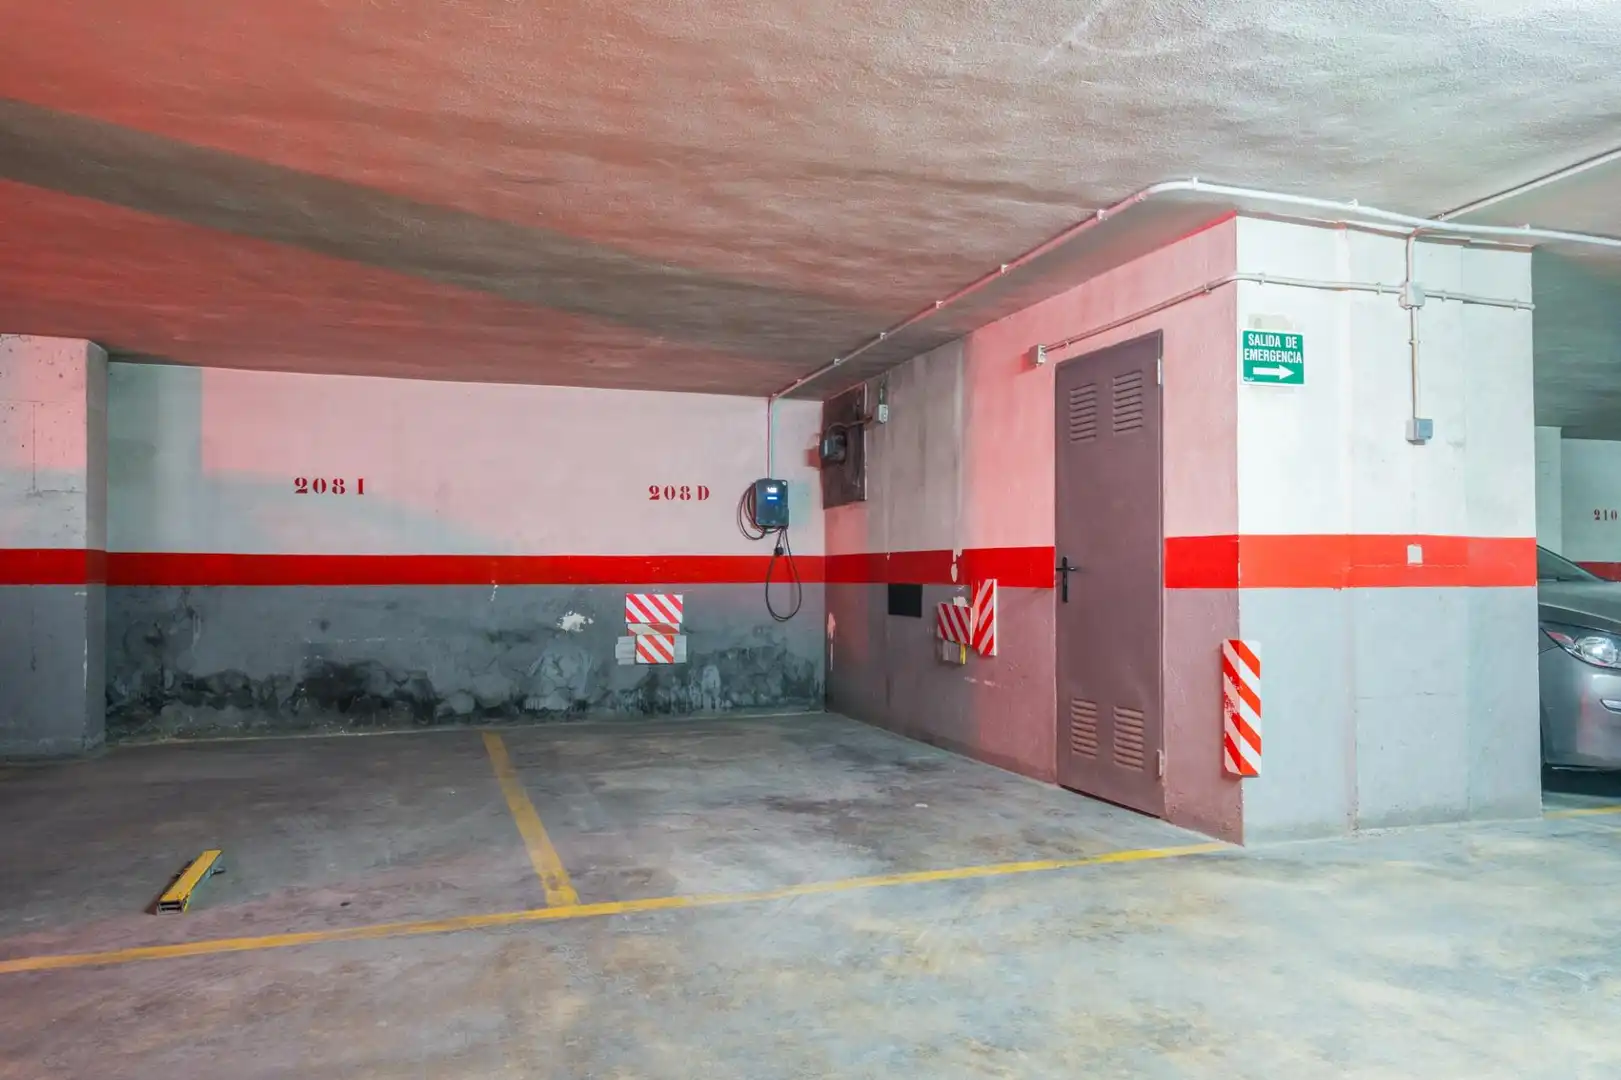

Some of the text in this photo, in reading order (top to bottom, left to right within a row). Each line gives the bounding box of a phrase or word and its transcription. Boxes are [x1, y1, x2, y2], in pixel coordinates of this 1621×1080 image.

[1248, 333, 1298, 349] SALIDA DE
[1244, 348, 1303, 364] EMERGENCIA
[1593, 508, 1618, 521] 210
